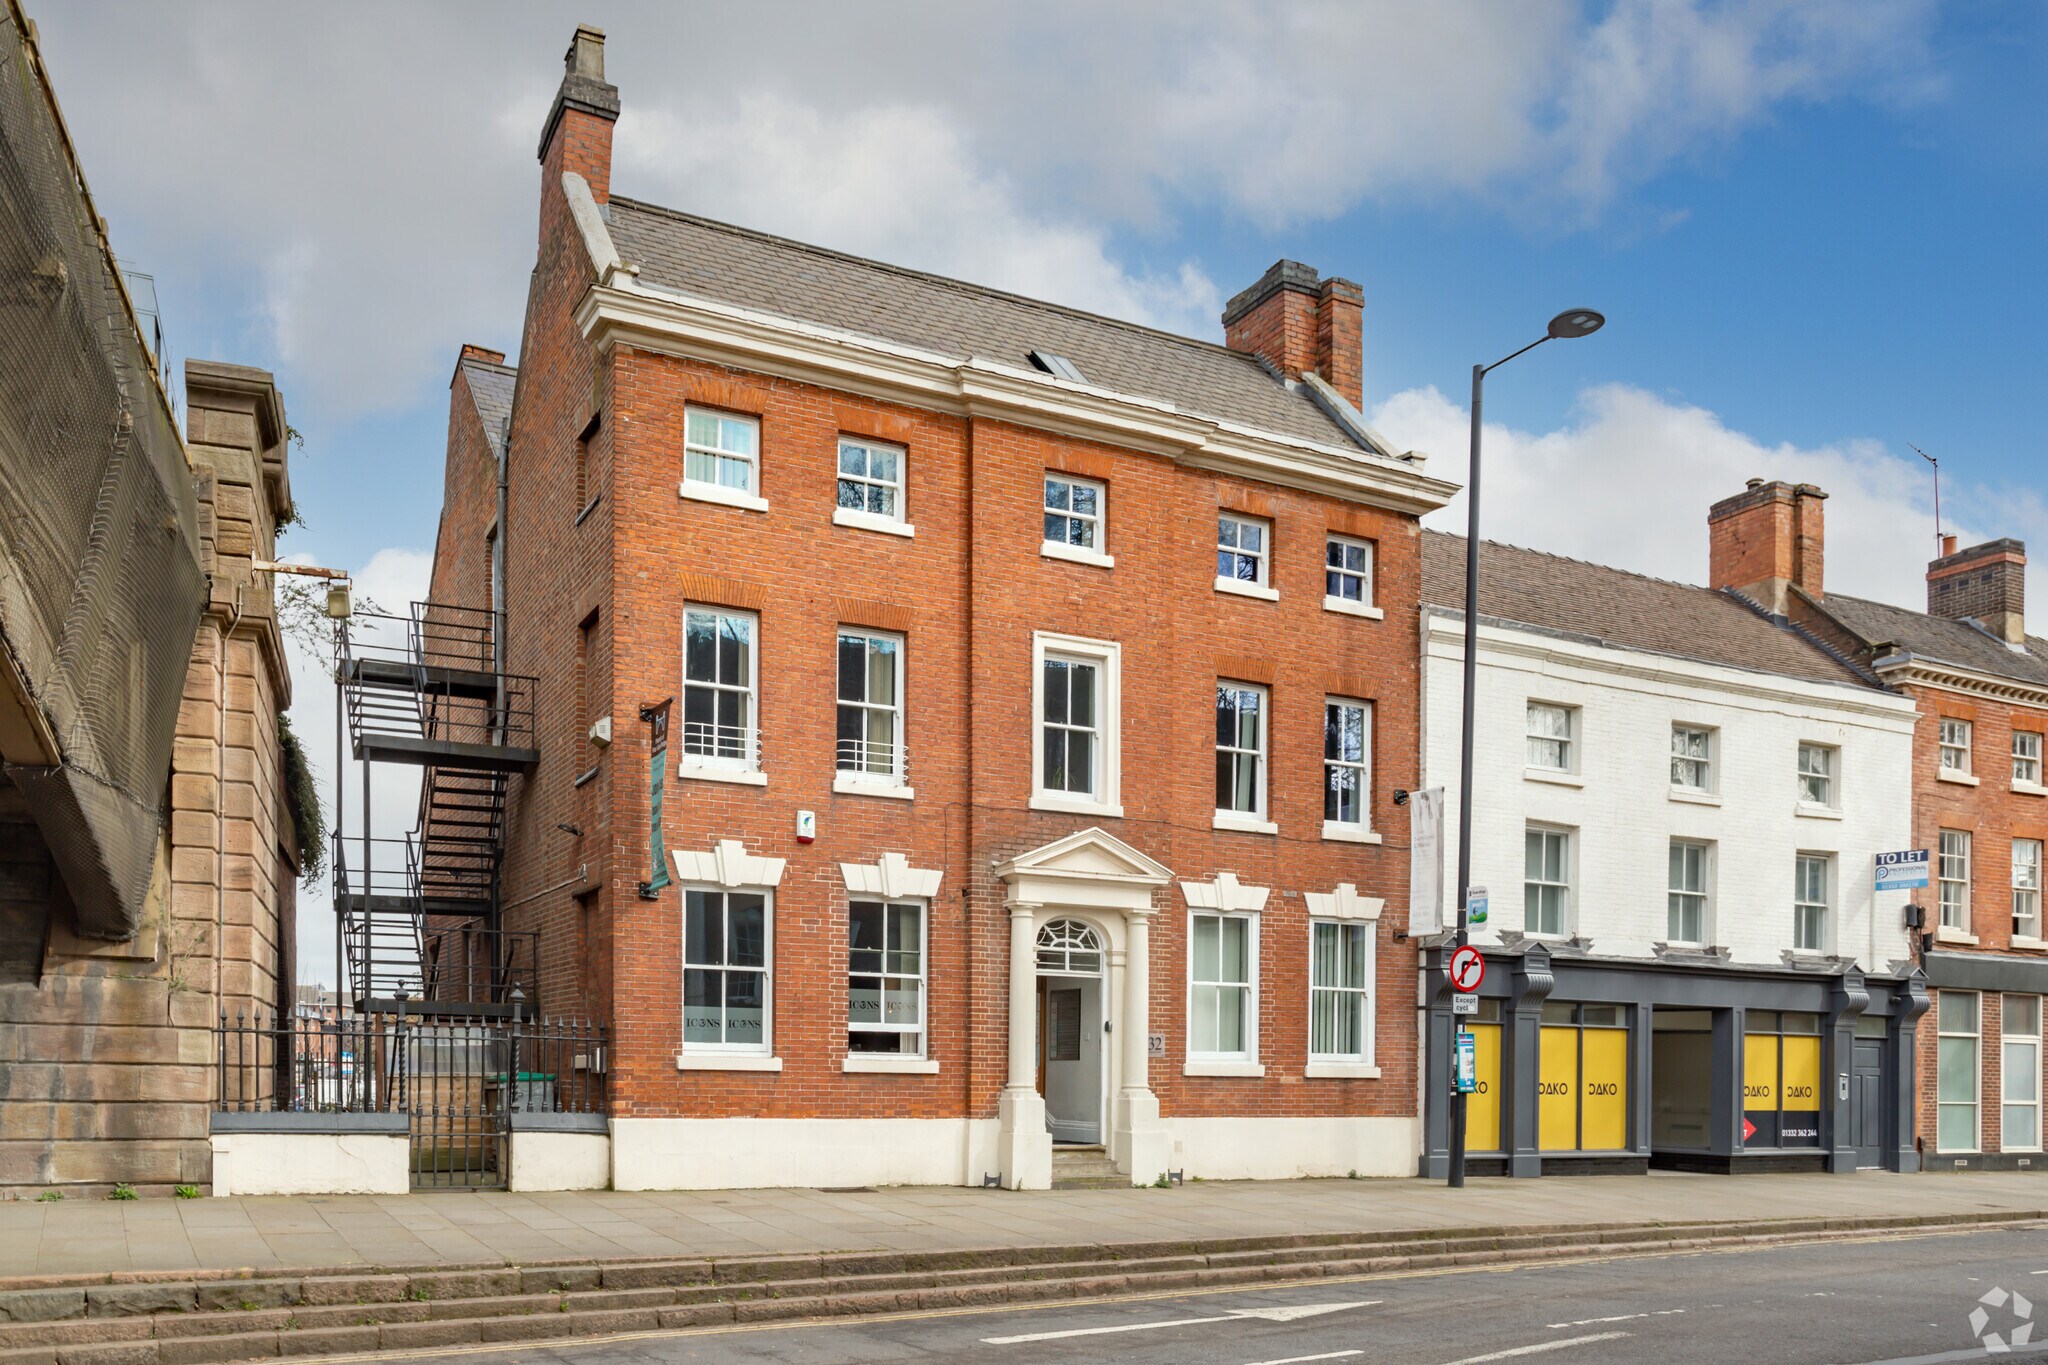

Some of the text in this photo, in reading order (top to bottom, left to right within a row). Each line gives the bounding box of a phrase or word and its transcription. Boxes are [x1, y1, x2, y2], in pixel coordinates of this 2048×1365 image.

[1879, 851, 1924, 864] TO LET
[849, 1000, 880, 1010] ICONS
[1455, 996, 1476, 1005] Except
[686, 1018, 721, 1028] ICONS
[728, 1019, 761, 1029] ICONS
[1148, 1037, 1162, 1050] 32
